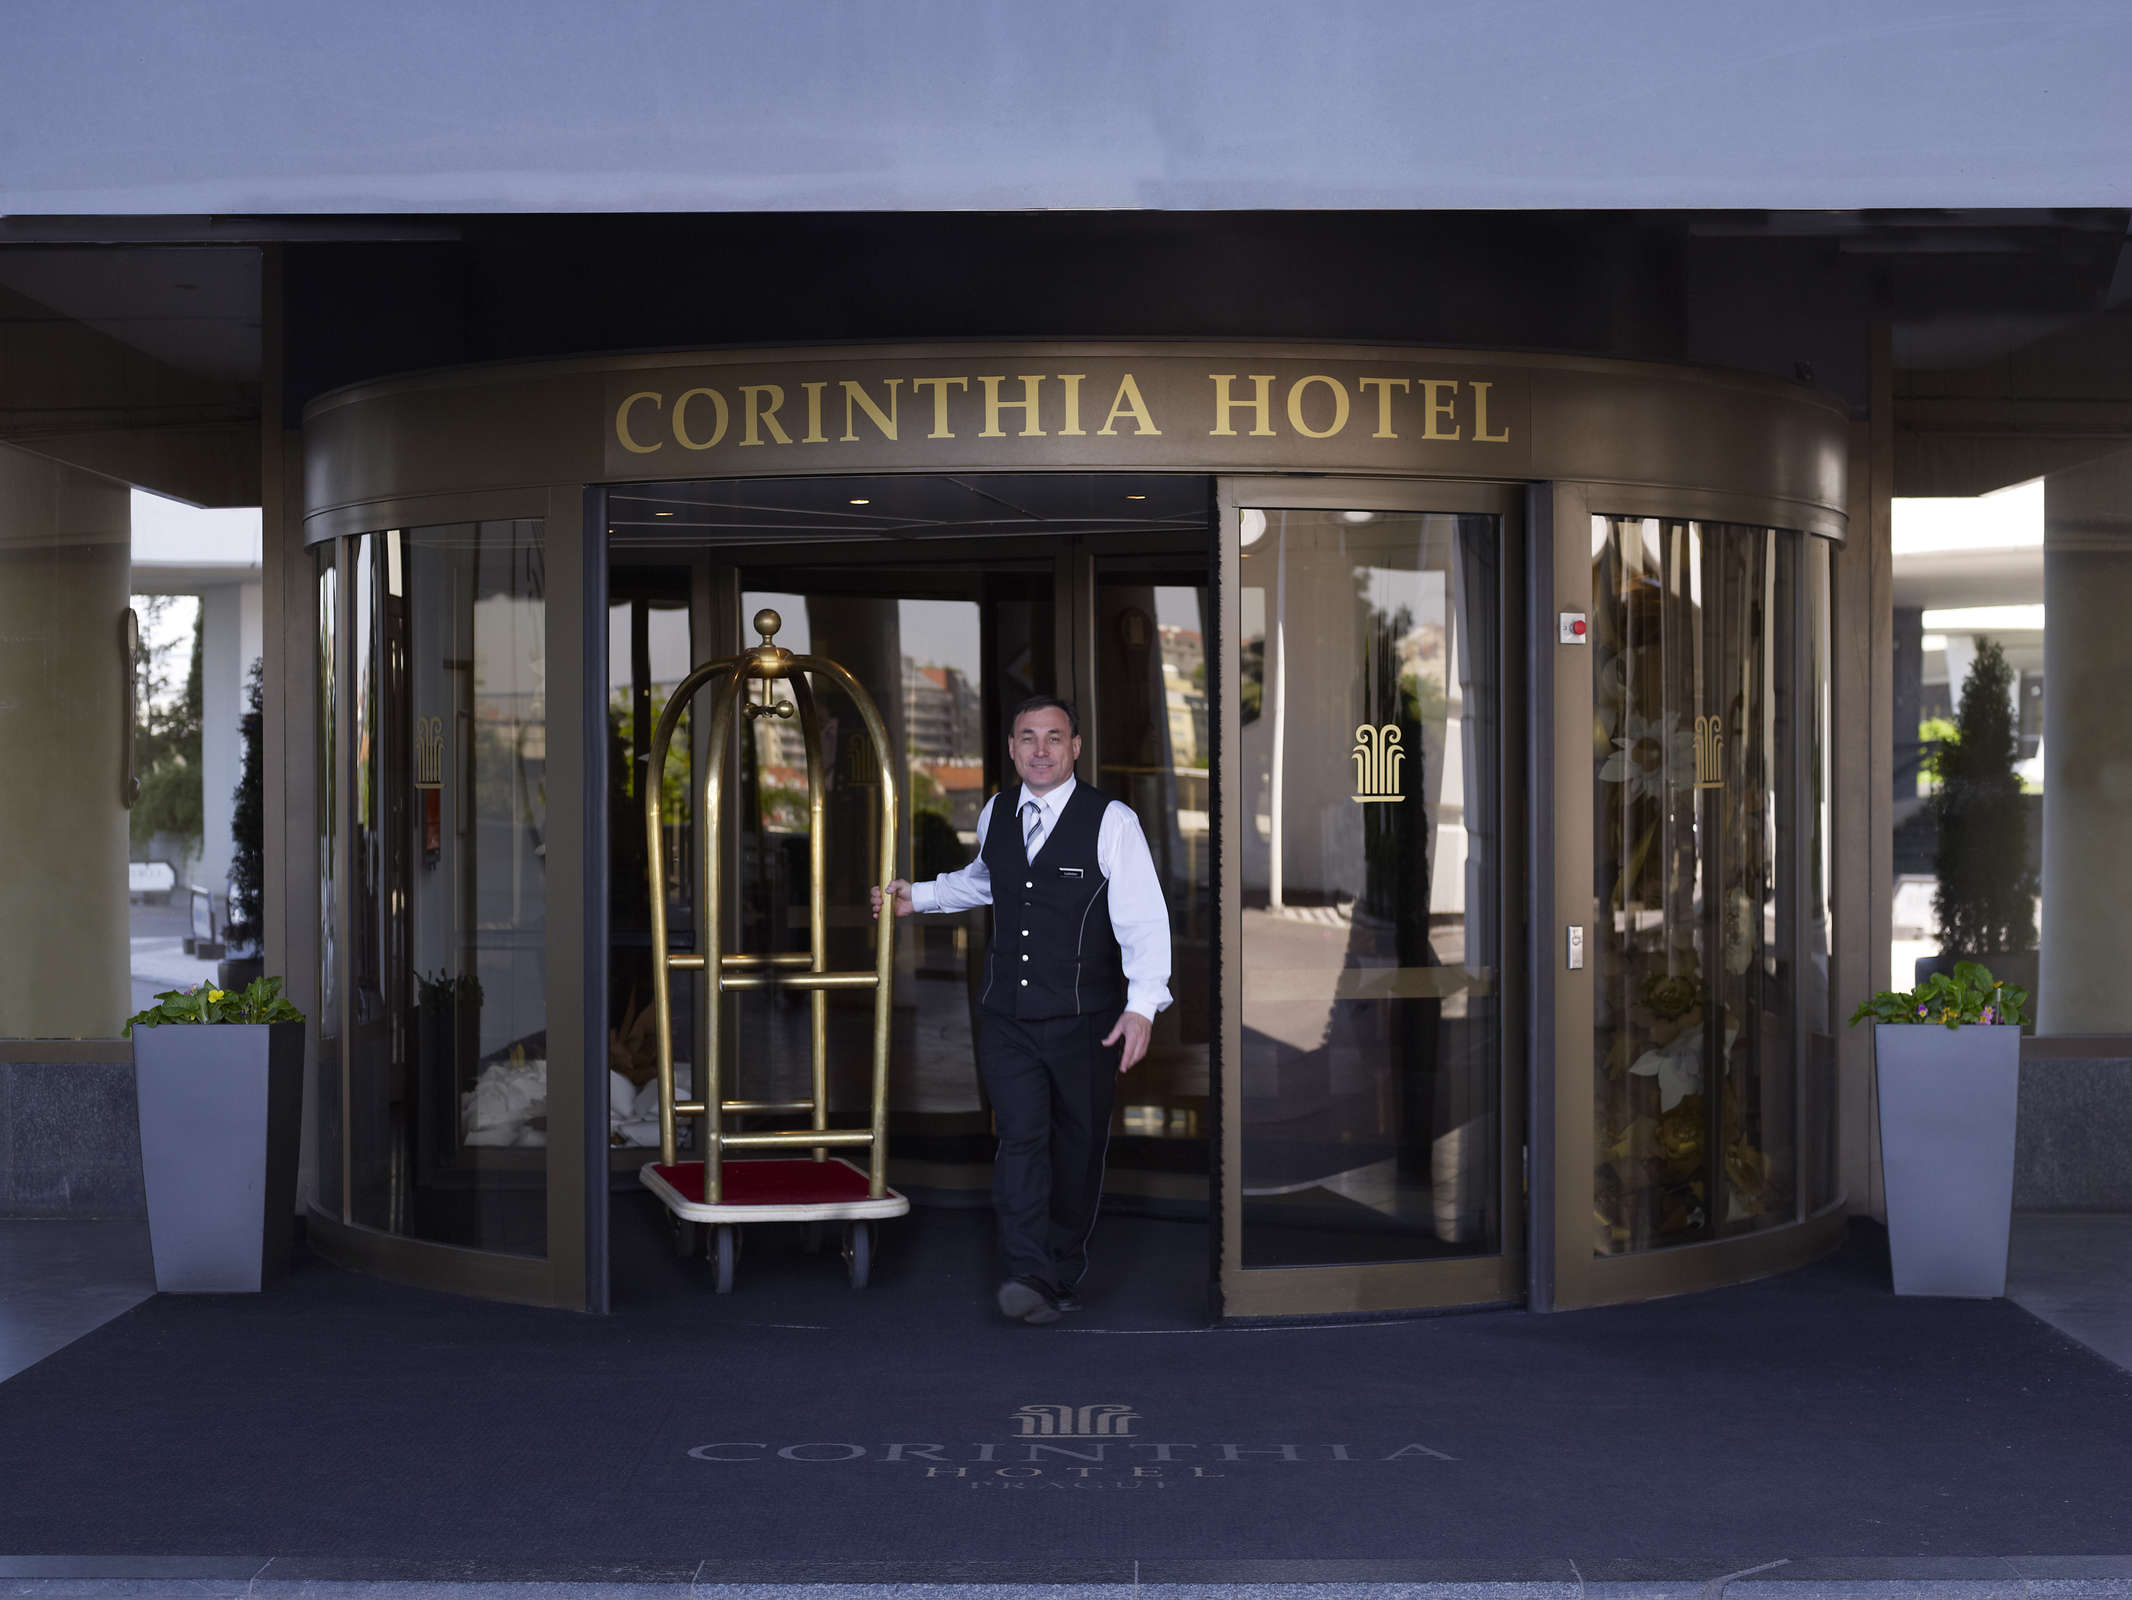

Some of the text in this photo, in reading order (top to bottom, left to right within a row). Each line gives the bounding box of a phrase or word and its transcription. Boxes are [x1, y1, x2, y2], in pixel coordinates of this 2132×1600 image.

[615, 373, 1510, 454] CORINTHIA HOTEL
[687, 1442, 1459, 1462] CORINTHIA
[925, 1466, 1226, 1478] HOTEL
